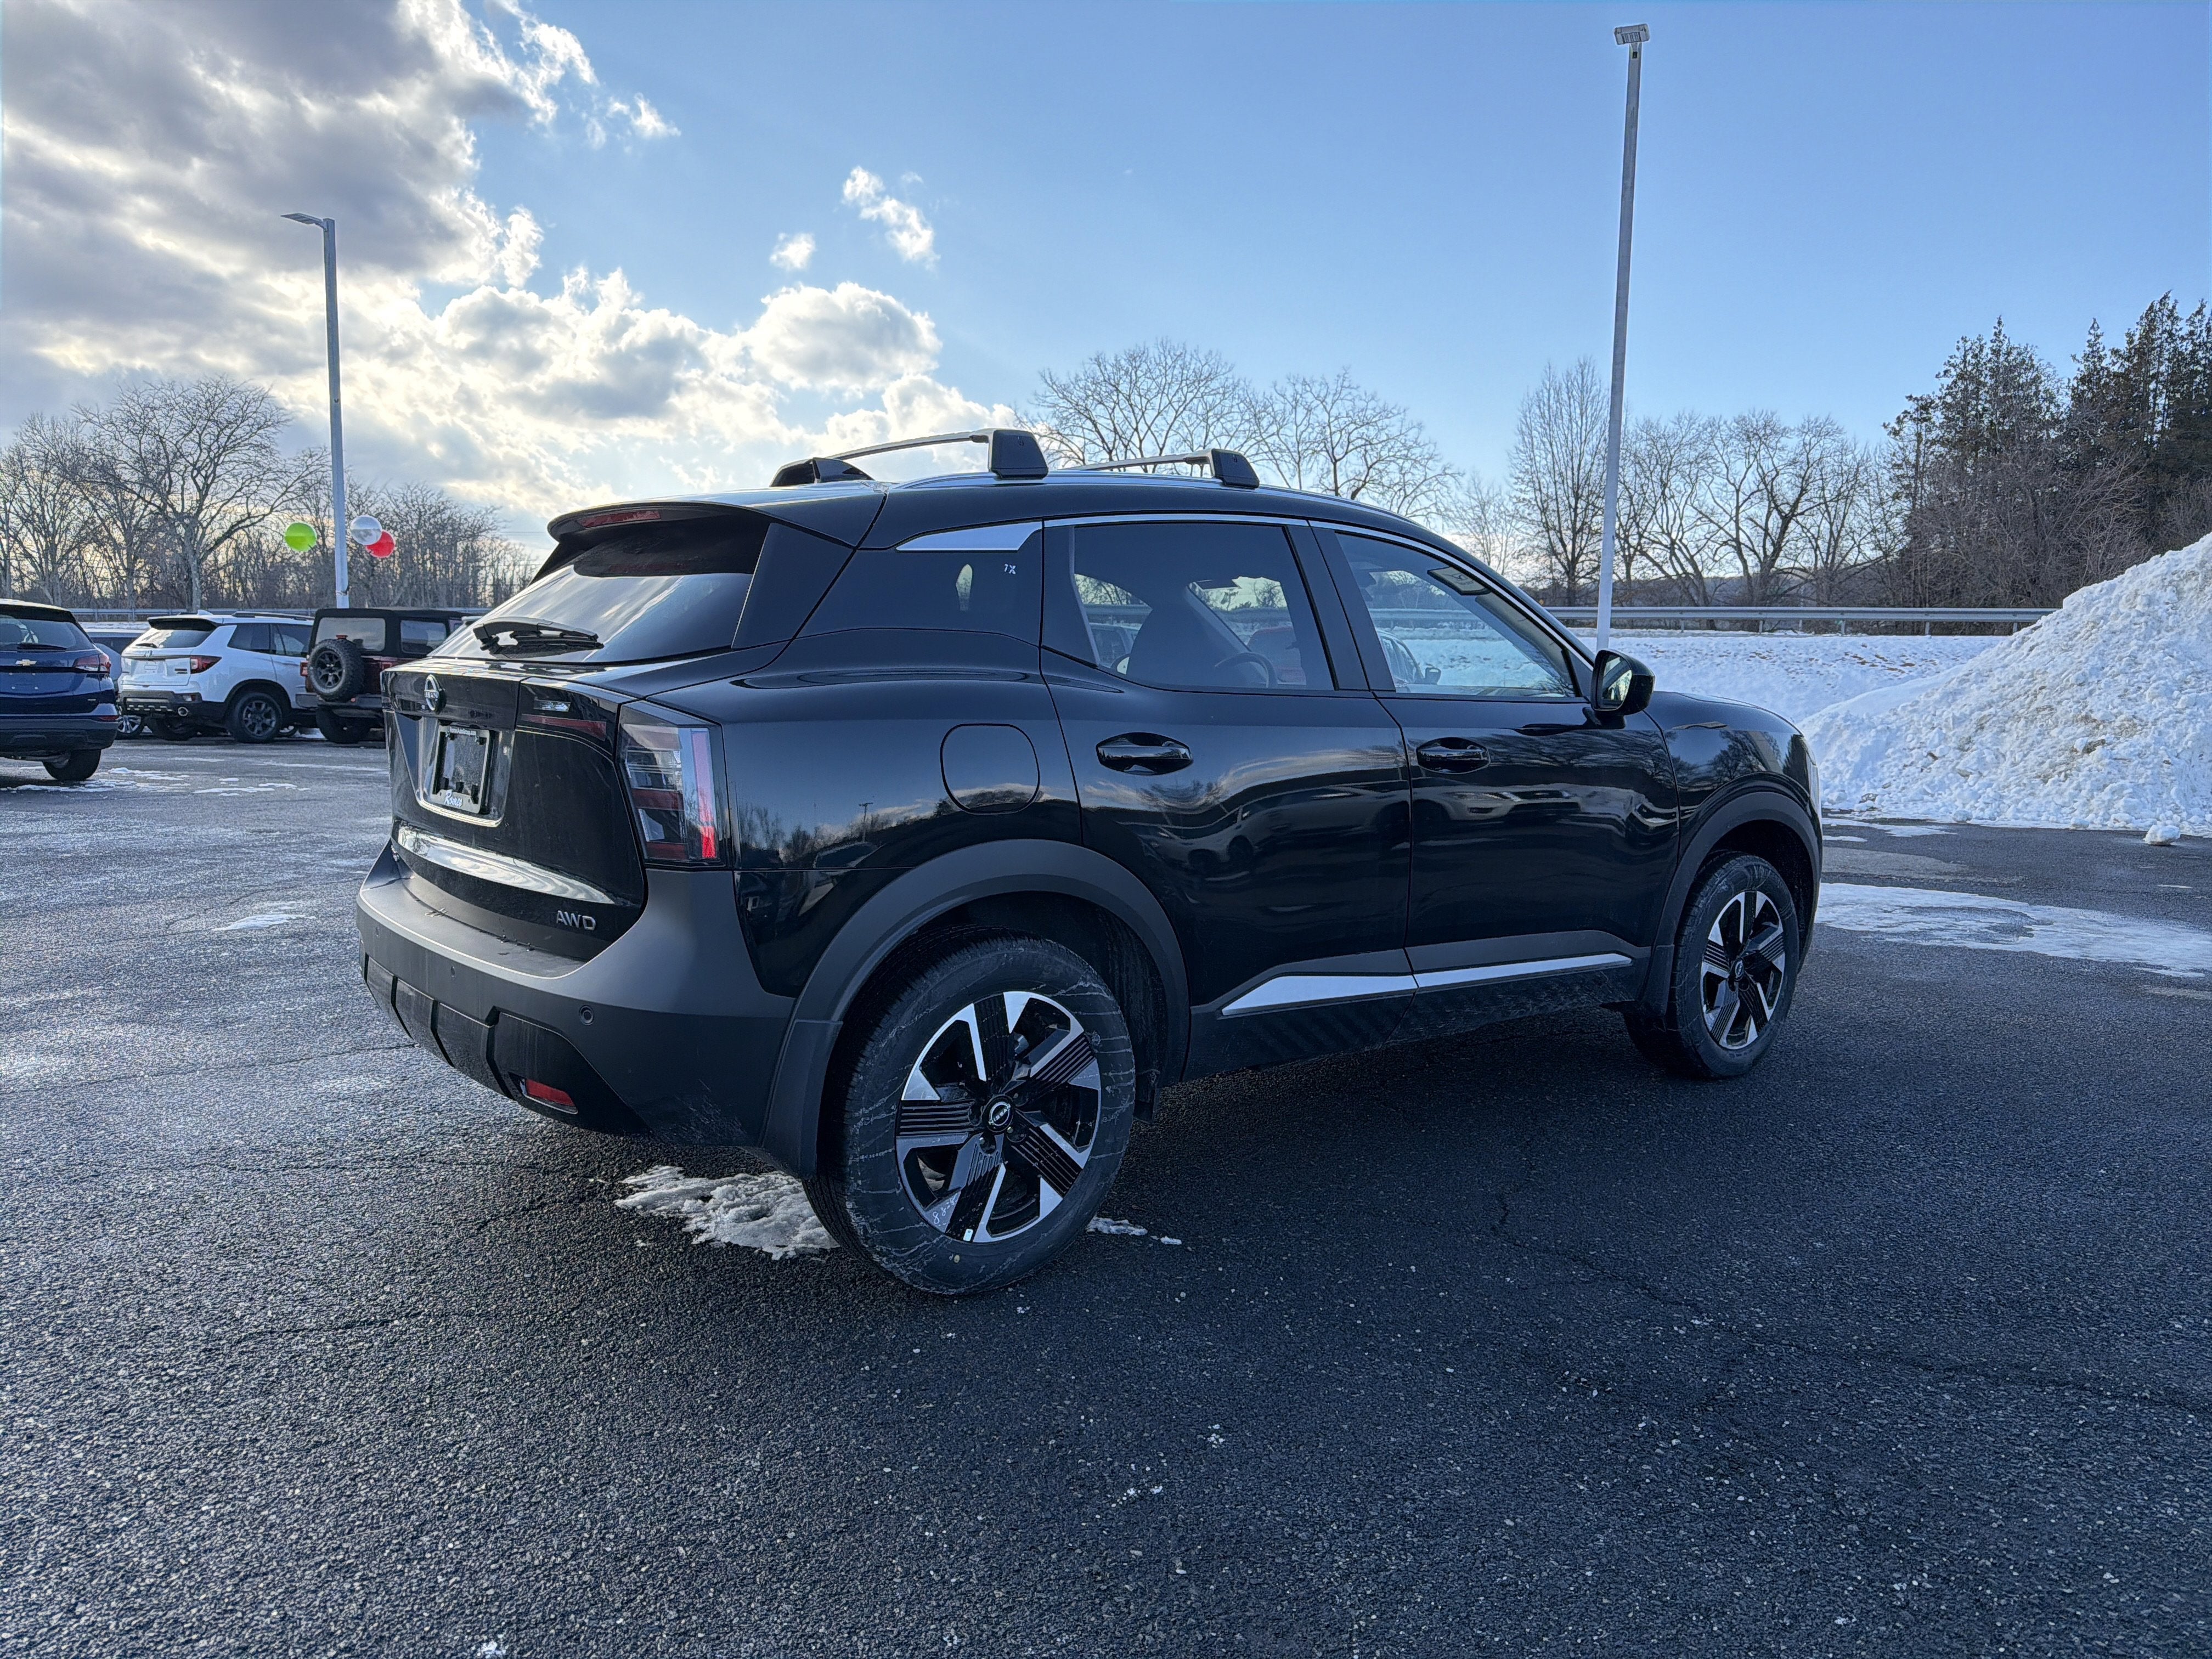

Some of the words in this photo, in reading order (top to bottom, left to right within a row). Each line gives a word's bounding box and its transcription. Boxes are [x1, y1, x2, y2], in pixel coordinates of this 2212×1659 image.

[444, 789, 462, 808] Romeo
[556, 910, 596, 931] AWD
[988, 1103, 1011, 1125] NISSAN
